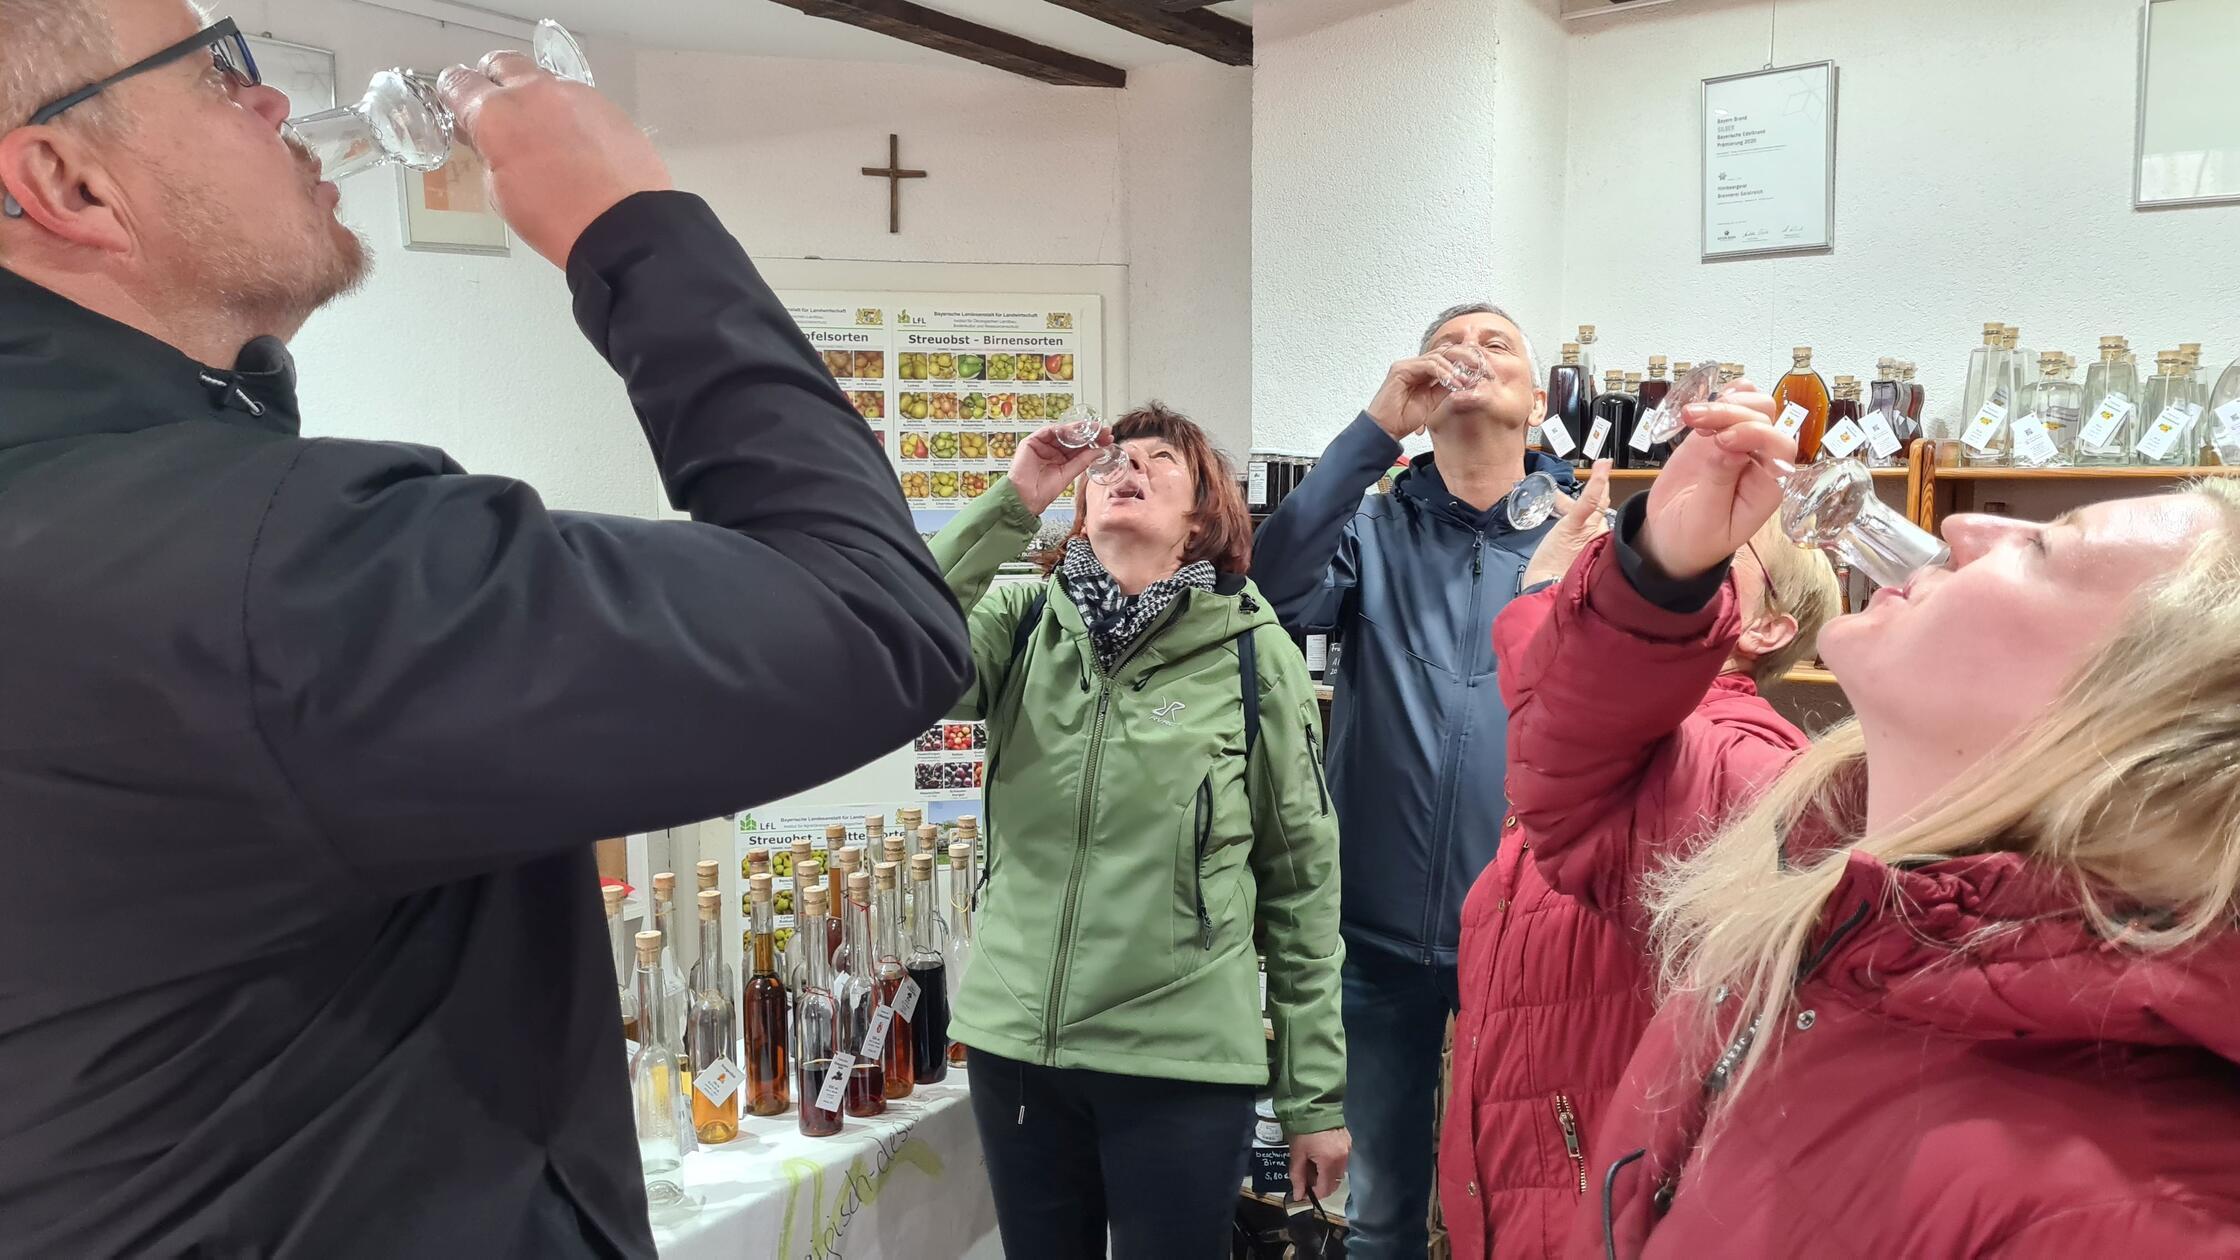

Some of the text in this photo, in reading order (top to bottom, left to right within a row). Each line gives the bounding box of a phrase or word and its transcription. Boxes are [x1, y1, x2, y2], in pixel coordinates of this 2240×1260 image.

[912, 317, 927, 325] LfL
[908, 334, 971, 345] Streuobst
[983, 335, 1064, 347] Birnensorten
[760, 822, 776, 831] LfL
[749, 834, 812, 846] Streuobst
[1263, 1159, 1286, 1167] Birne
